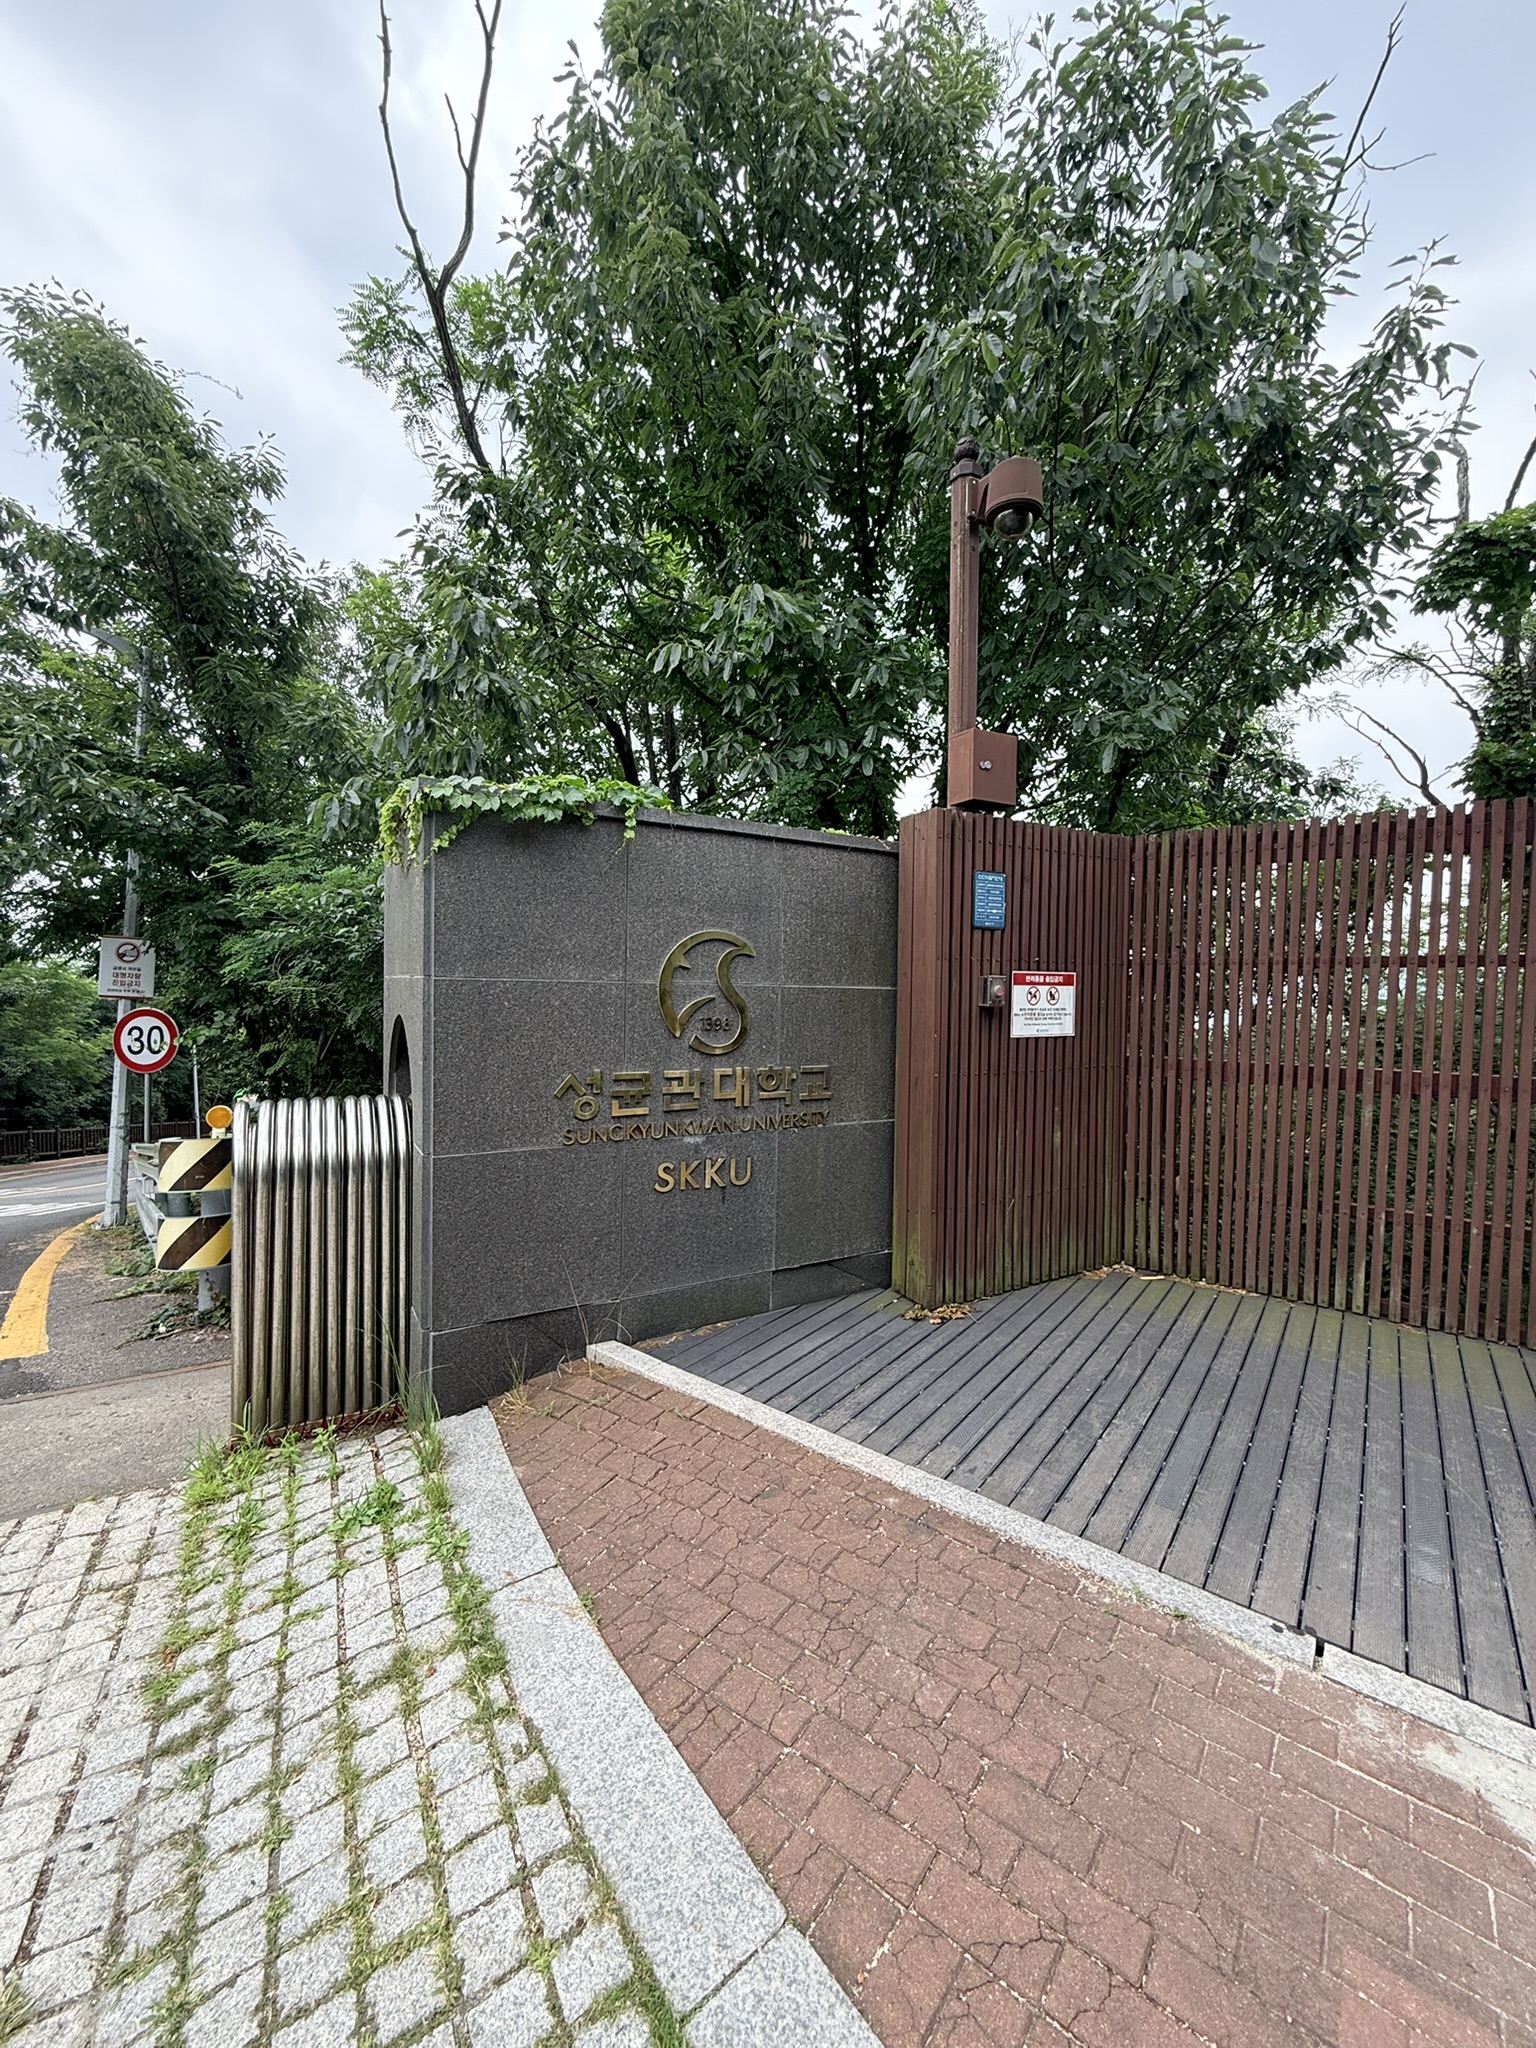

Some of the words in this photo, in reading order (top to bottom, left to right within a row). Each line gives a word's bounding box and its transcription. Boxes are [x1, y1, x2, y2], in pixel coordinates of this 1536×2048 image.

[112, 979, 141, 987] 진입금지
[127, 1025, 165, 1055] 30
[700, 1017, 730, 1031] 1398
[553, 1064, 833, 1121] 성균관대학교
[562, 1116, 735, 1146] SUNGKYUNKWAN
[740, 1110, 831, 1132] UNIVERSITY
[654, 1157, 752, 1193] SKKU
